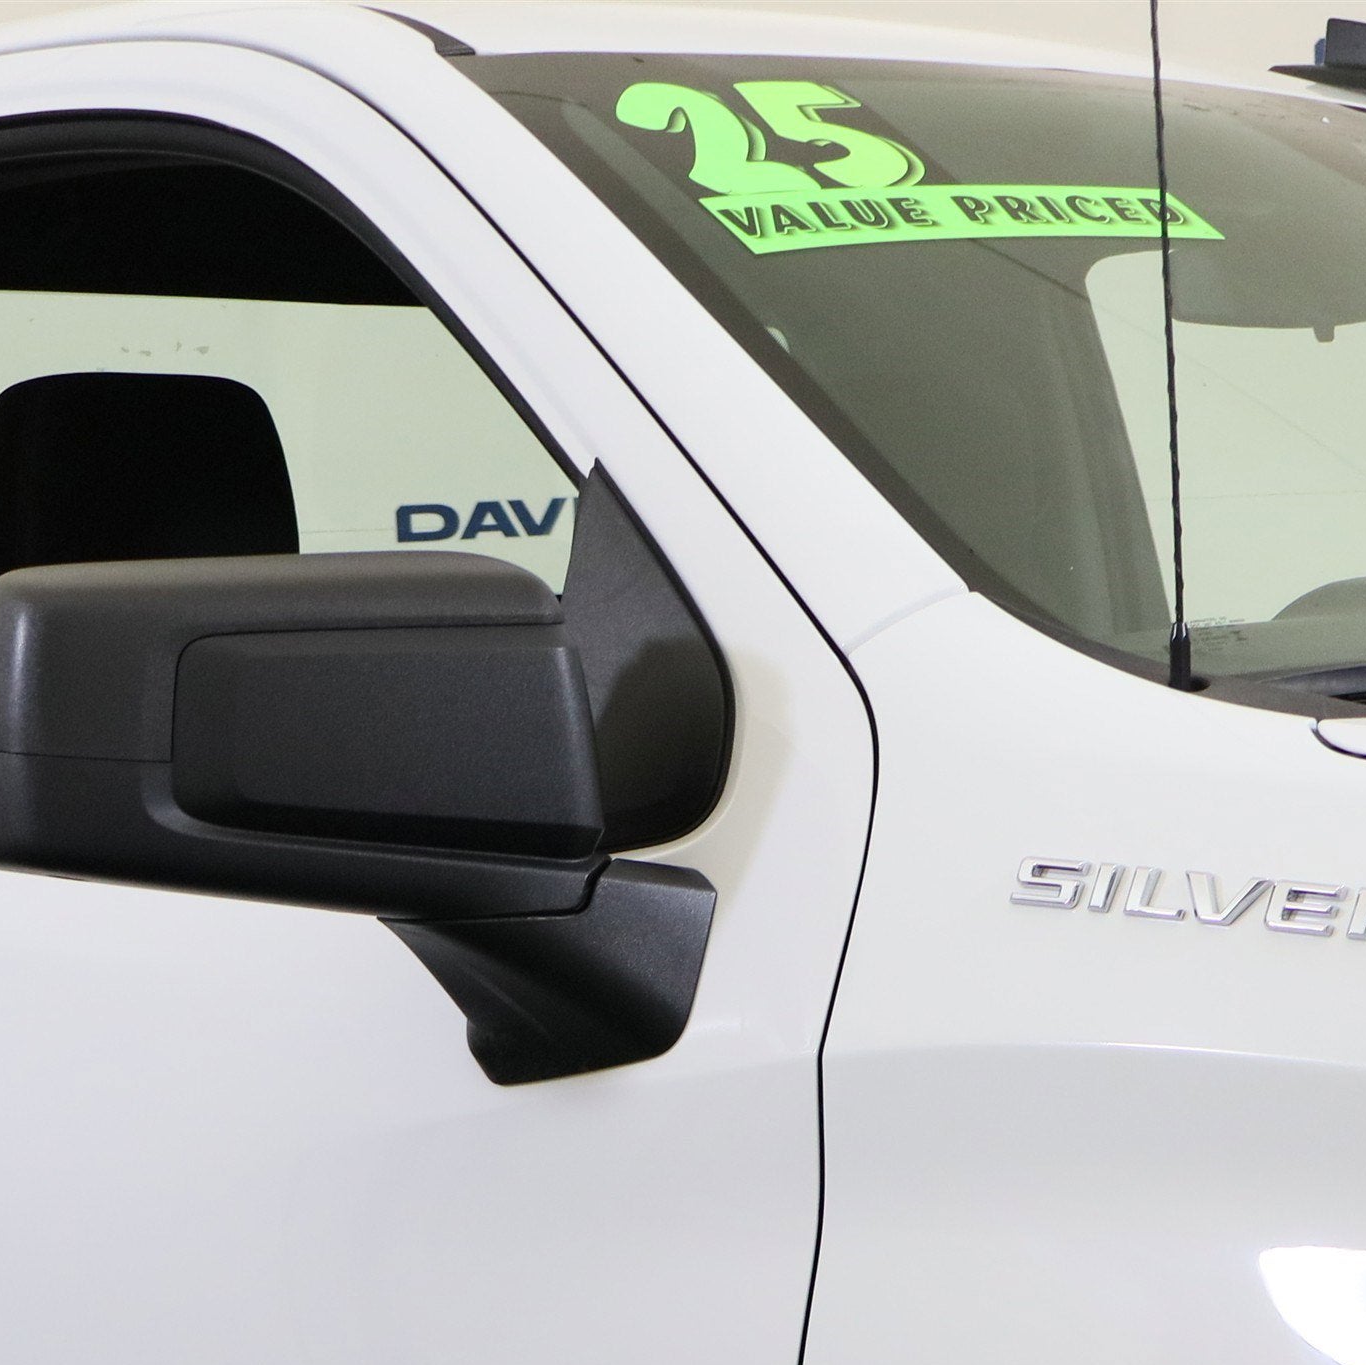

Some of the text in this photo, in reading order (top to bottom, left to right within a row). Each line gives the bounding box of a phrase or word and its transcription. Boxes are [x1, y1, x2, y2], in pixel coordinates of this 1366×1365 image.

[615, 81, 926, 195] 25
[720, 194, 1195, 239] VALUE PRICED
[396, 497, 579, 543] DAV
